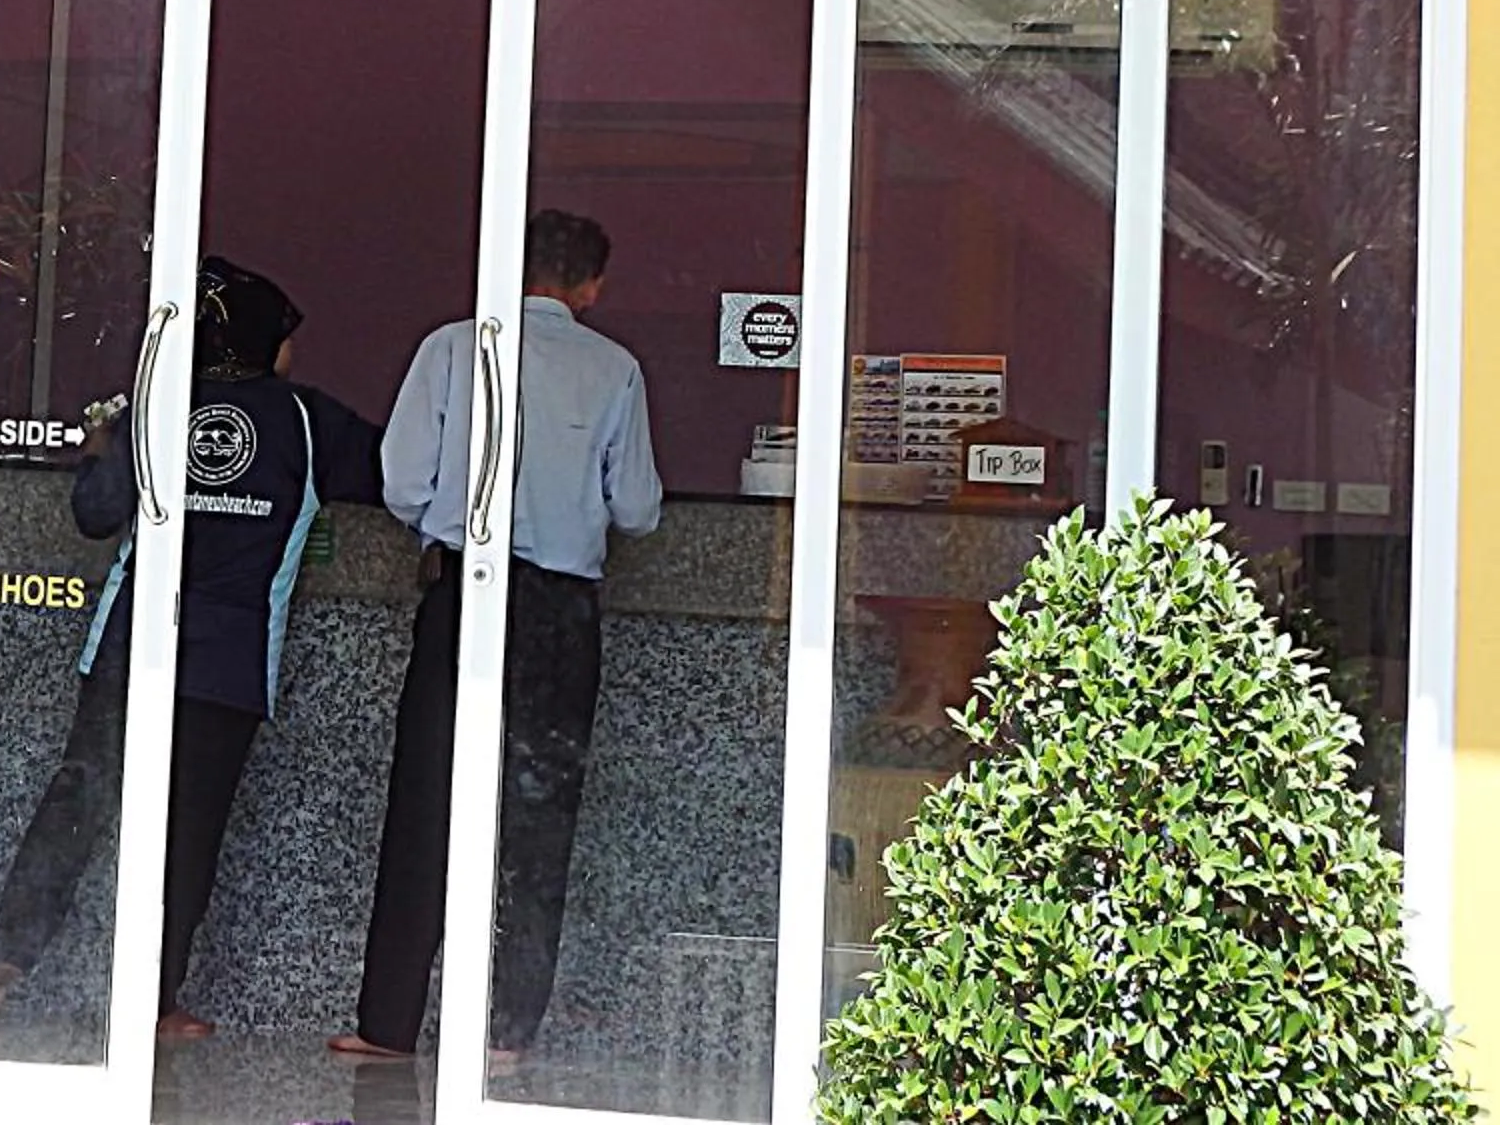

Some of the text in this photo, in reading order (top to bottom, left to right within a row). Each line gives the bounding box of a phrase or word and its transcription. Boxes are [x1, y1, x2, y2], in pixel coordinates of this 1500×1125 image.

[753, 312, 788, 326] every
[745, 324, 795, 335] moment
[747, 334, 793, 346] matters
[0, 418, 63, 448] SIDE
[975, 447, 1042, 476] Tip Box
